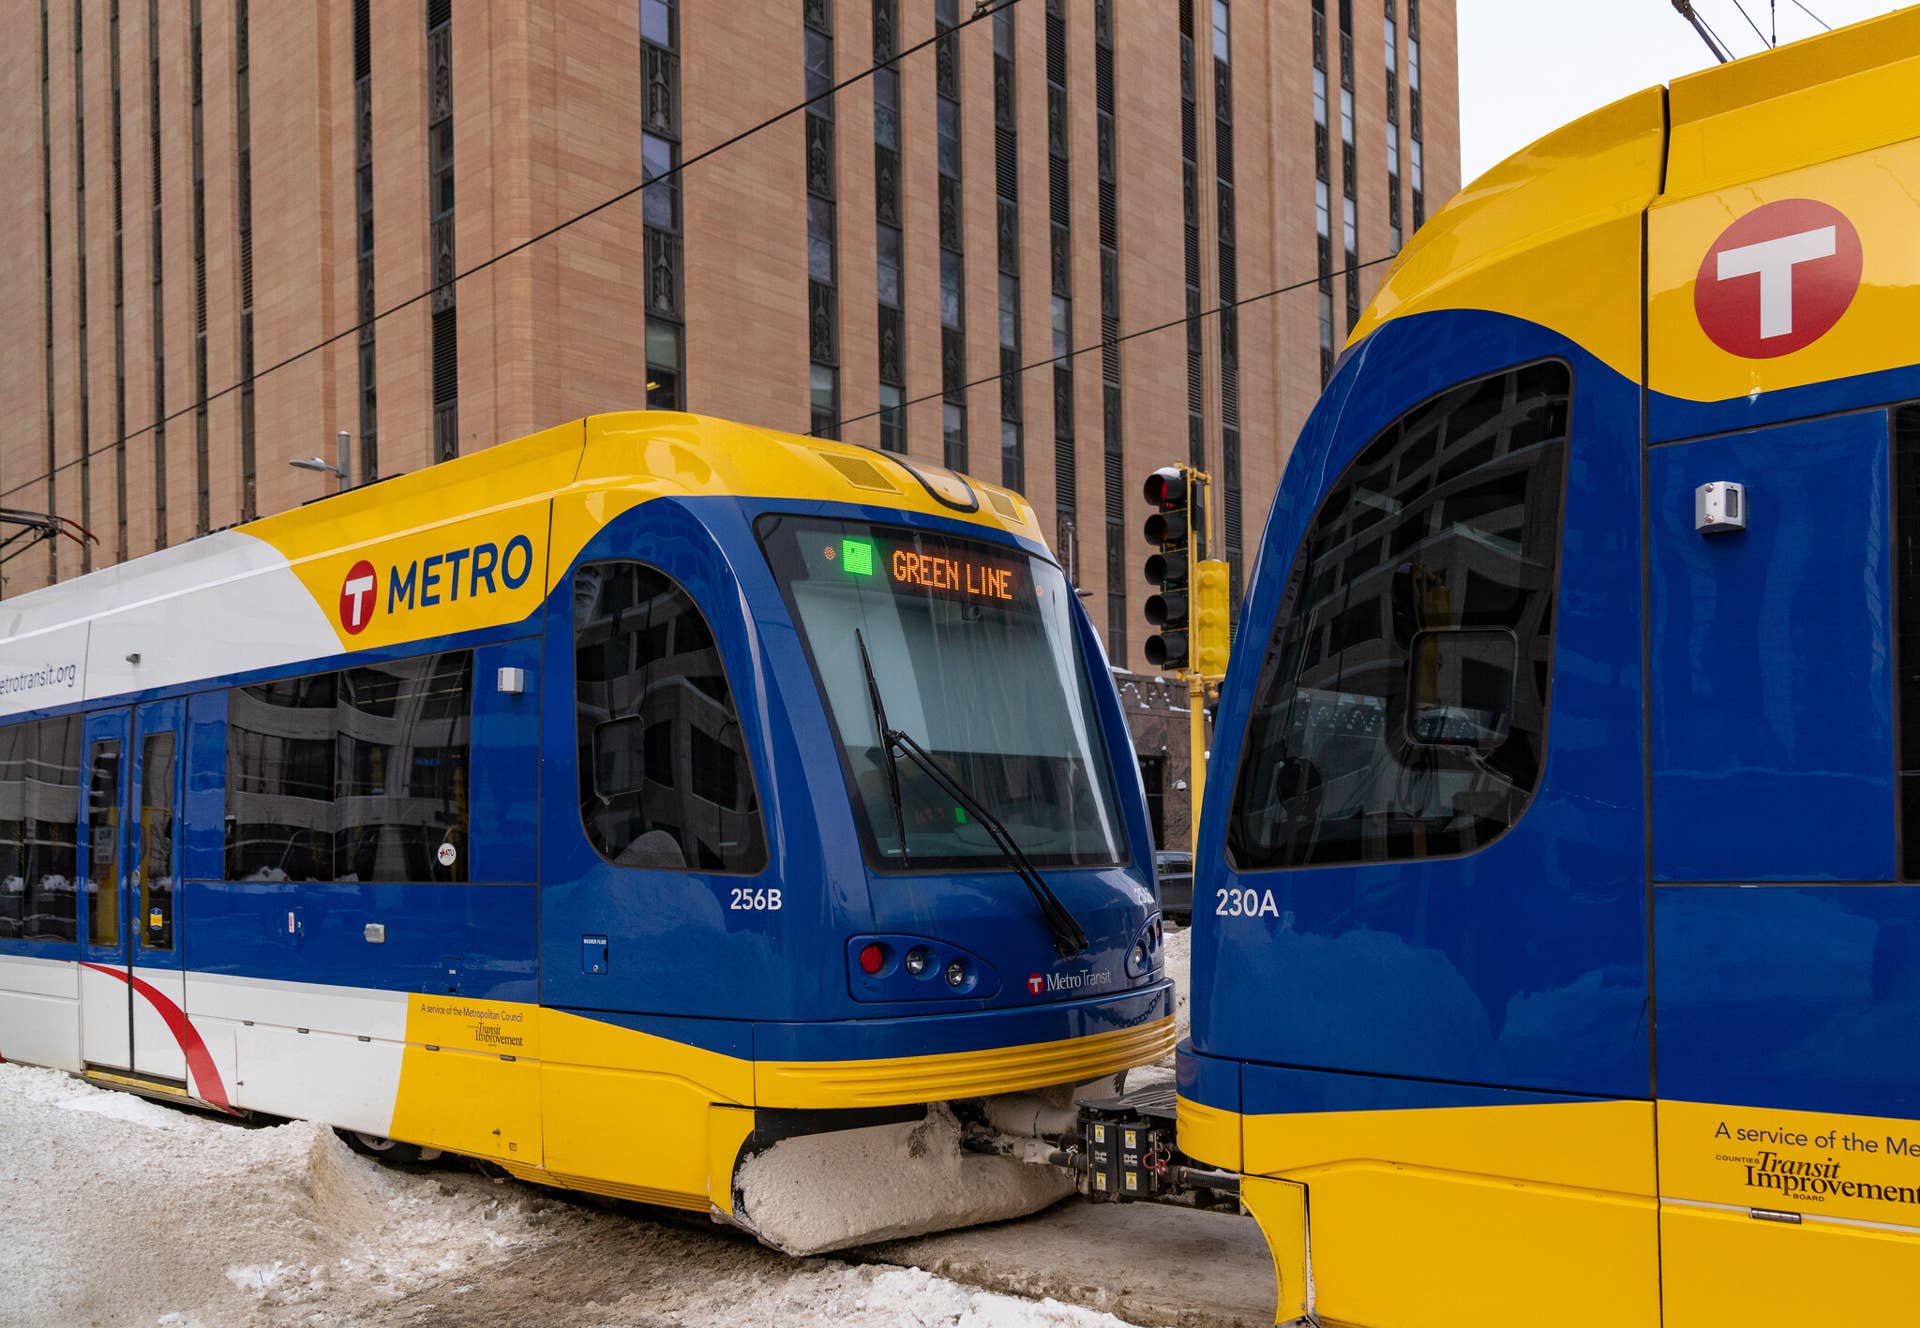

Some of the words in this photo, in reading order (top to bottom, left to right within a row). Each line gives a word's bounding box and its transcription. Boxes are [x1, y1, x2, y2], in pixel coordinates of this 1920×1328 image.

[387, 534, 533, 615] METRO
[892, 550, 960, 591] GREEN
[966, 562, 1013, 600] LINE
[730, 888, 782, 911] 256B
[1215, 888, 1280, 918] 230A
[421, 1003, 426, 1012] A
[426, 1005, 445, 1015] service
[446, 1006, 453, 1015] of
[453, 1006, 462, 1017] the
[463, 1008, 500, 1020] Metropolitan
[501, 1010, 523, 1023] Council
[475, 1029, 523, 1047] Improvement
[478, 1021, 501, 1034] Transit
[1715, 1122, 1731, 1139] A
[1737, 1127, 1808, 1147] service
[1815, 1130, 1836, 1149] of
[1842, 1132, 1878, 1153] the
[1715, 1154, 1760, 1165] COUNTIES
[1757, 1151, 1841, 1179] Transit
[1793, 1193, 1825, 1202] BOARD
